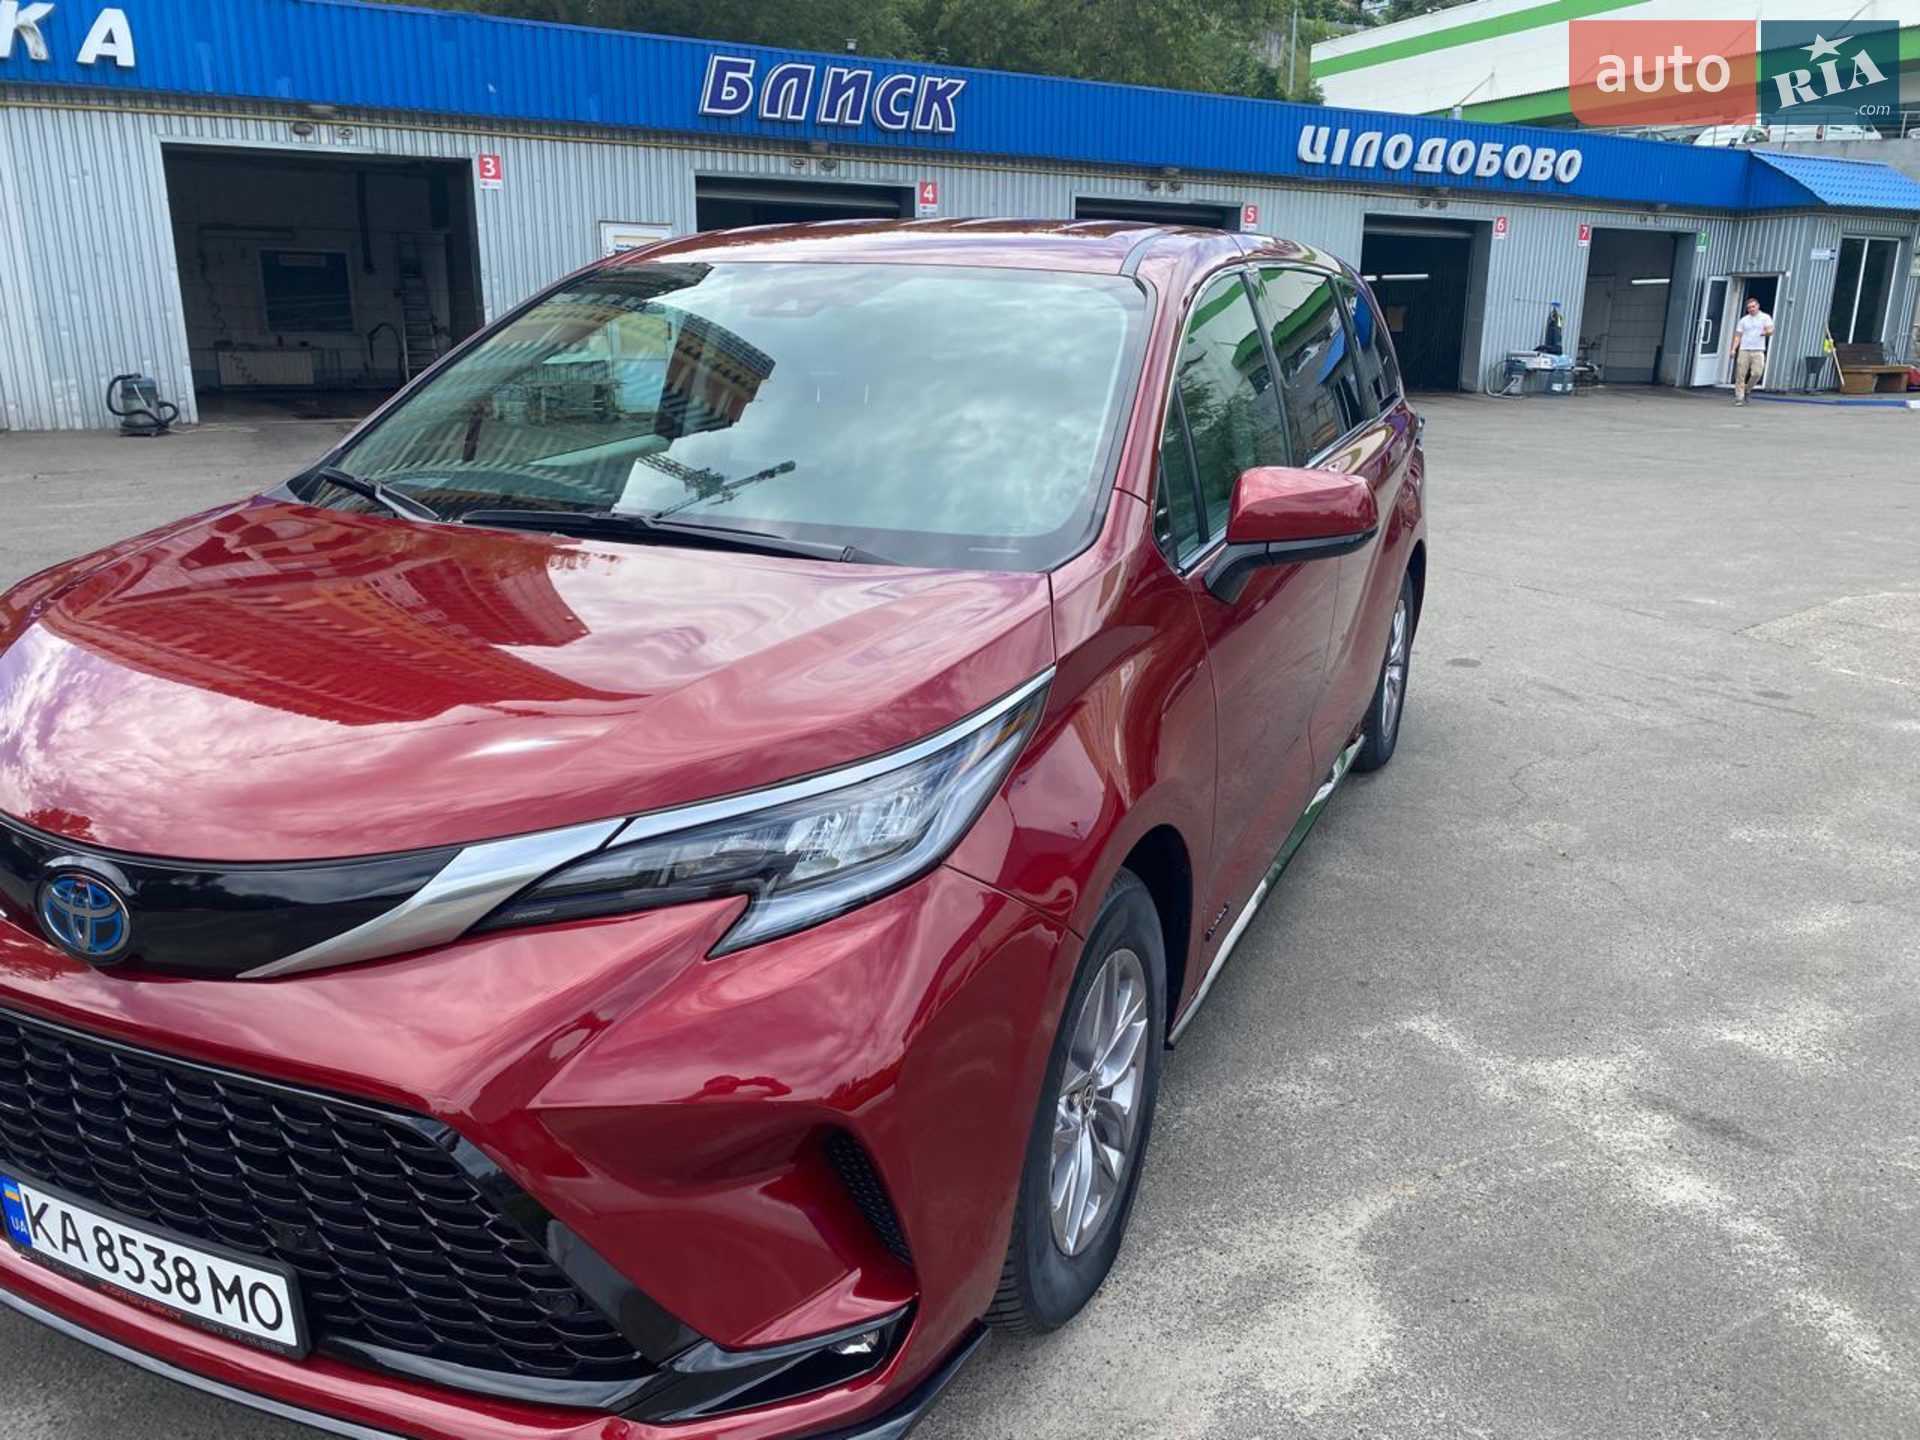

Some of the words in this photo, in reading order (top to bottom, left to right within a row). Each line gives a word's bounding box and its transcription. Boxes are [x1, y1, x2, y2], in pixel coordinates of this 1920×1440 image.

[699, 53, 967, 133] БЛИСК
[1298, 125, 1583, 183] ЦІЛОДОБОВО
[482, 157, 496, 177] 3
[923, 184, 934, 202] 4
[1246, 207, 1256, 222] 5
[1496, 218, 1506, 232] 6
[1582, 226, 1589, 240] 7
[10, 1215, 29, 1236] UA
[24, 1194, 88, 1262] KA
[92, 1224, 202, 1306] 8538
